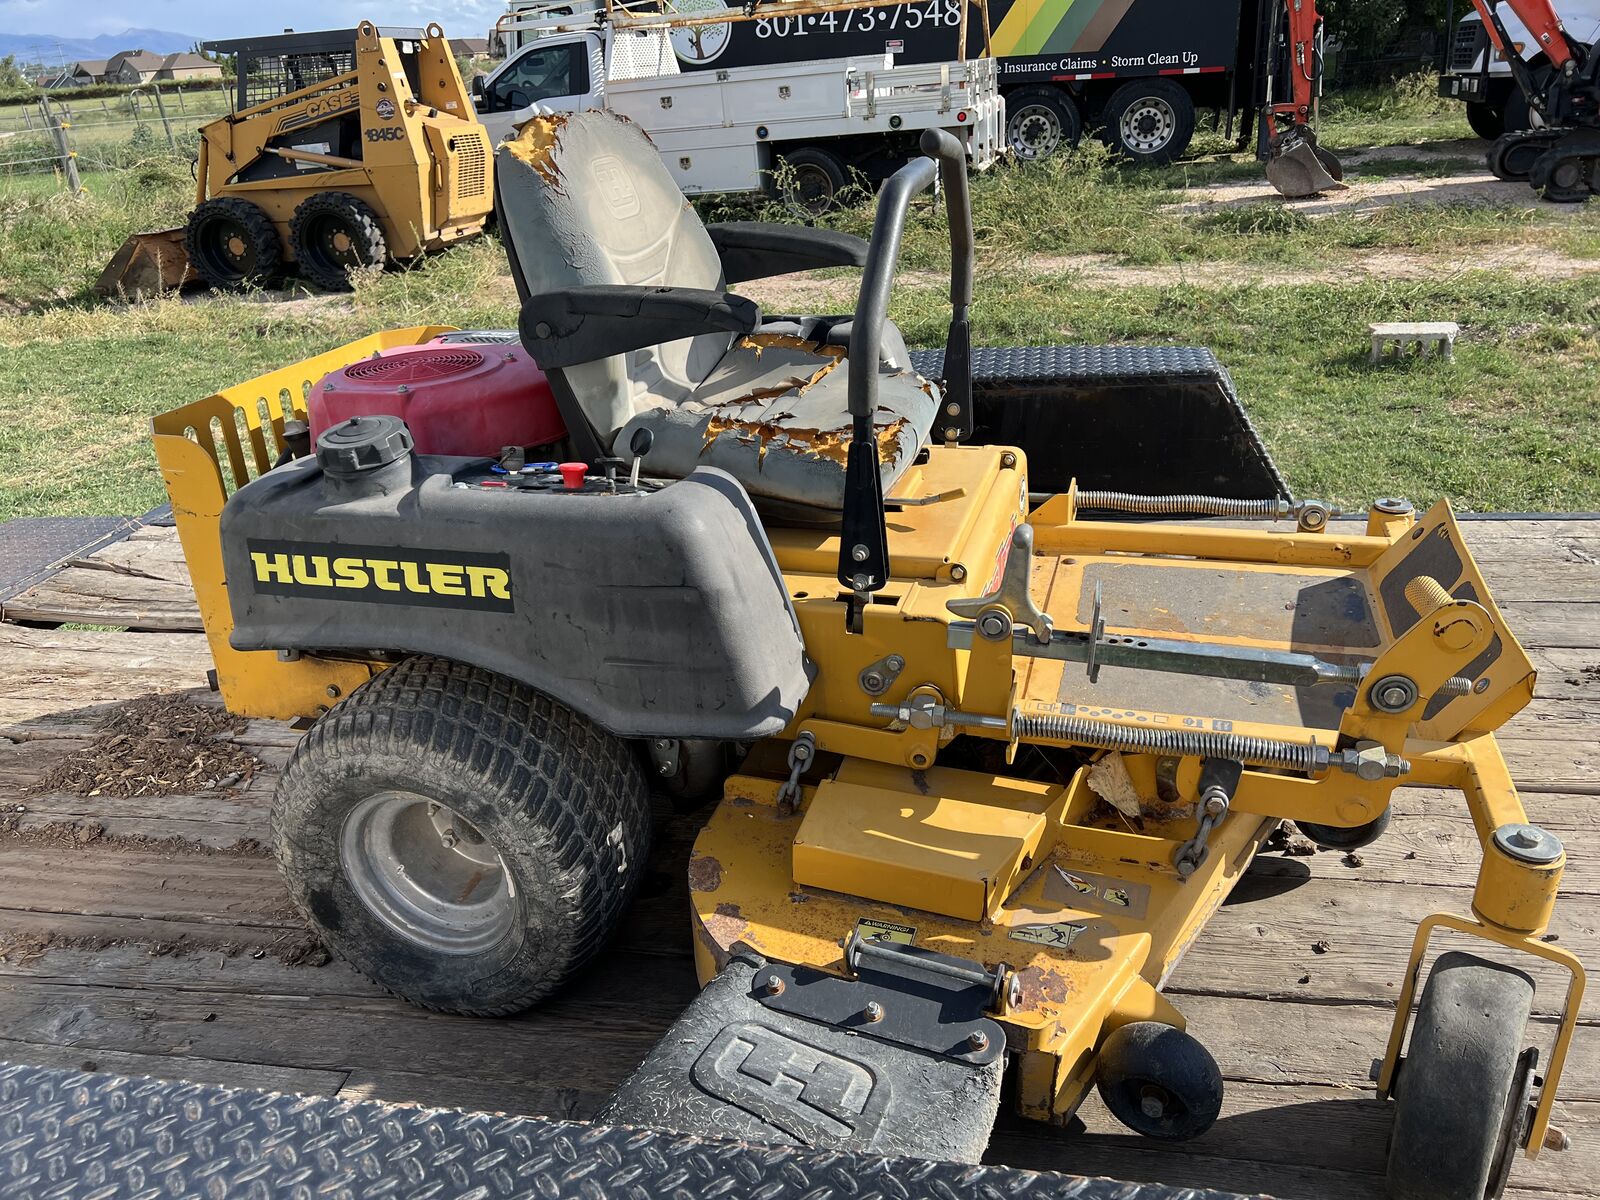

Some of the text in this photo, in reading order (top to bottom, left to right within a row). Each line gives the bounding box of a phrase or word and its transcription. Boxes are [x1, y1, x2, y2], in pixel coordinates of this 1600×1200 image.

[1004, 61, 1057, 74] Insurance
[1059, 58, 1097, 70] Claims
[1111, 55, 1145, 67] Storm
[1147, 53, 1179, 65] Clean
[1182, 51, 1199, 65] Up
[305, 91, 352, 118] CASE
[364, 126, 404, 142] 1845C
[250, 552, 511, 600] HUSTLER
